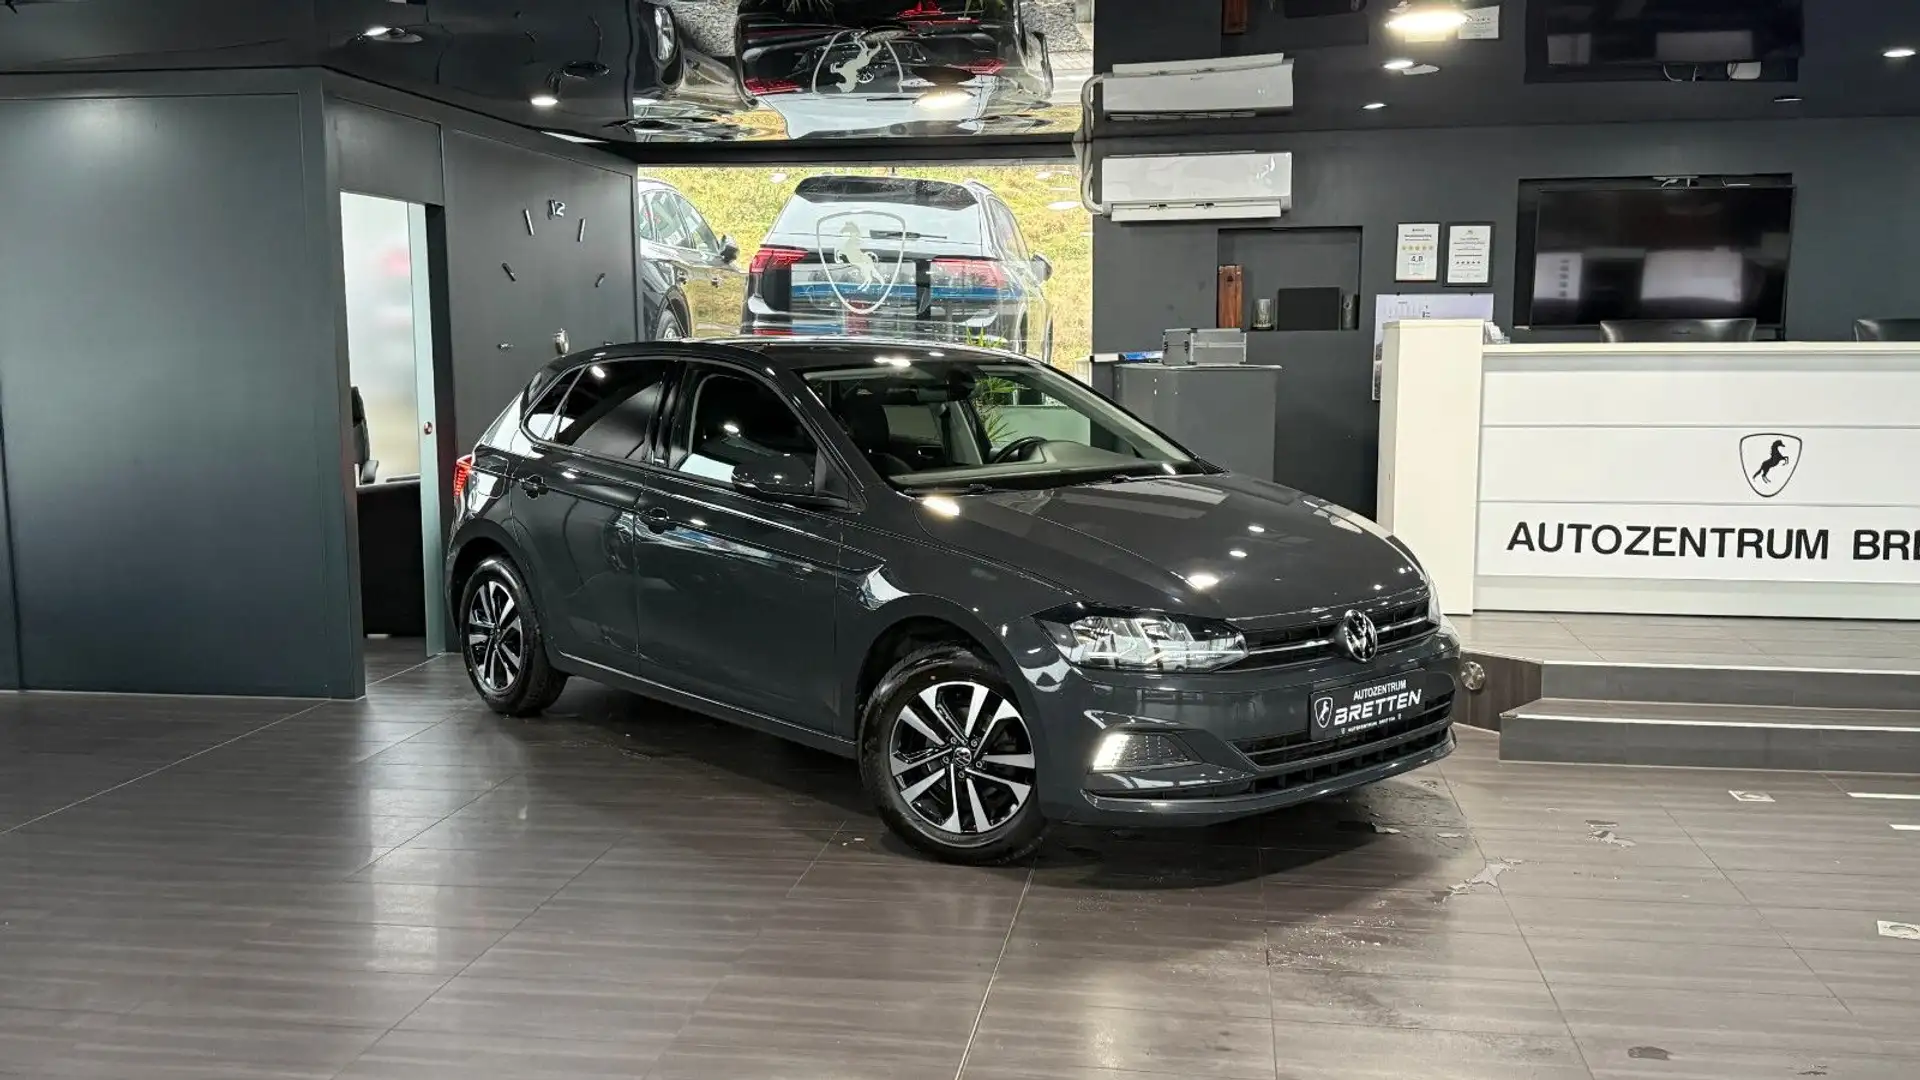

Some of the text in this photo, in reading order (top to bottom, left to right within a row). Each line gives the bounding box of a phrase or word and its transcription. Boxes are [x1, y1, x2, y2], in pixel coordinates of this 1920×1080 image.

[549, 200, 566, 217] 12
[1507, 521, 1920, 561] AUTOZENTRUM BR
[1353, 679, 1407, 700] AUTOZENTRUM
[1334, 688, 1422, 726] BRETTEN
